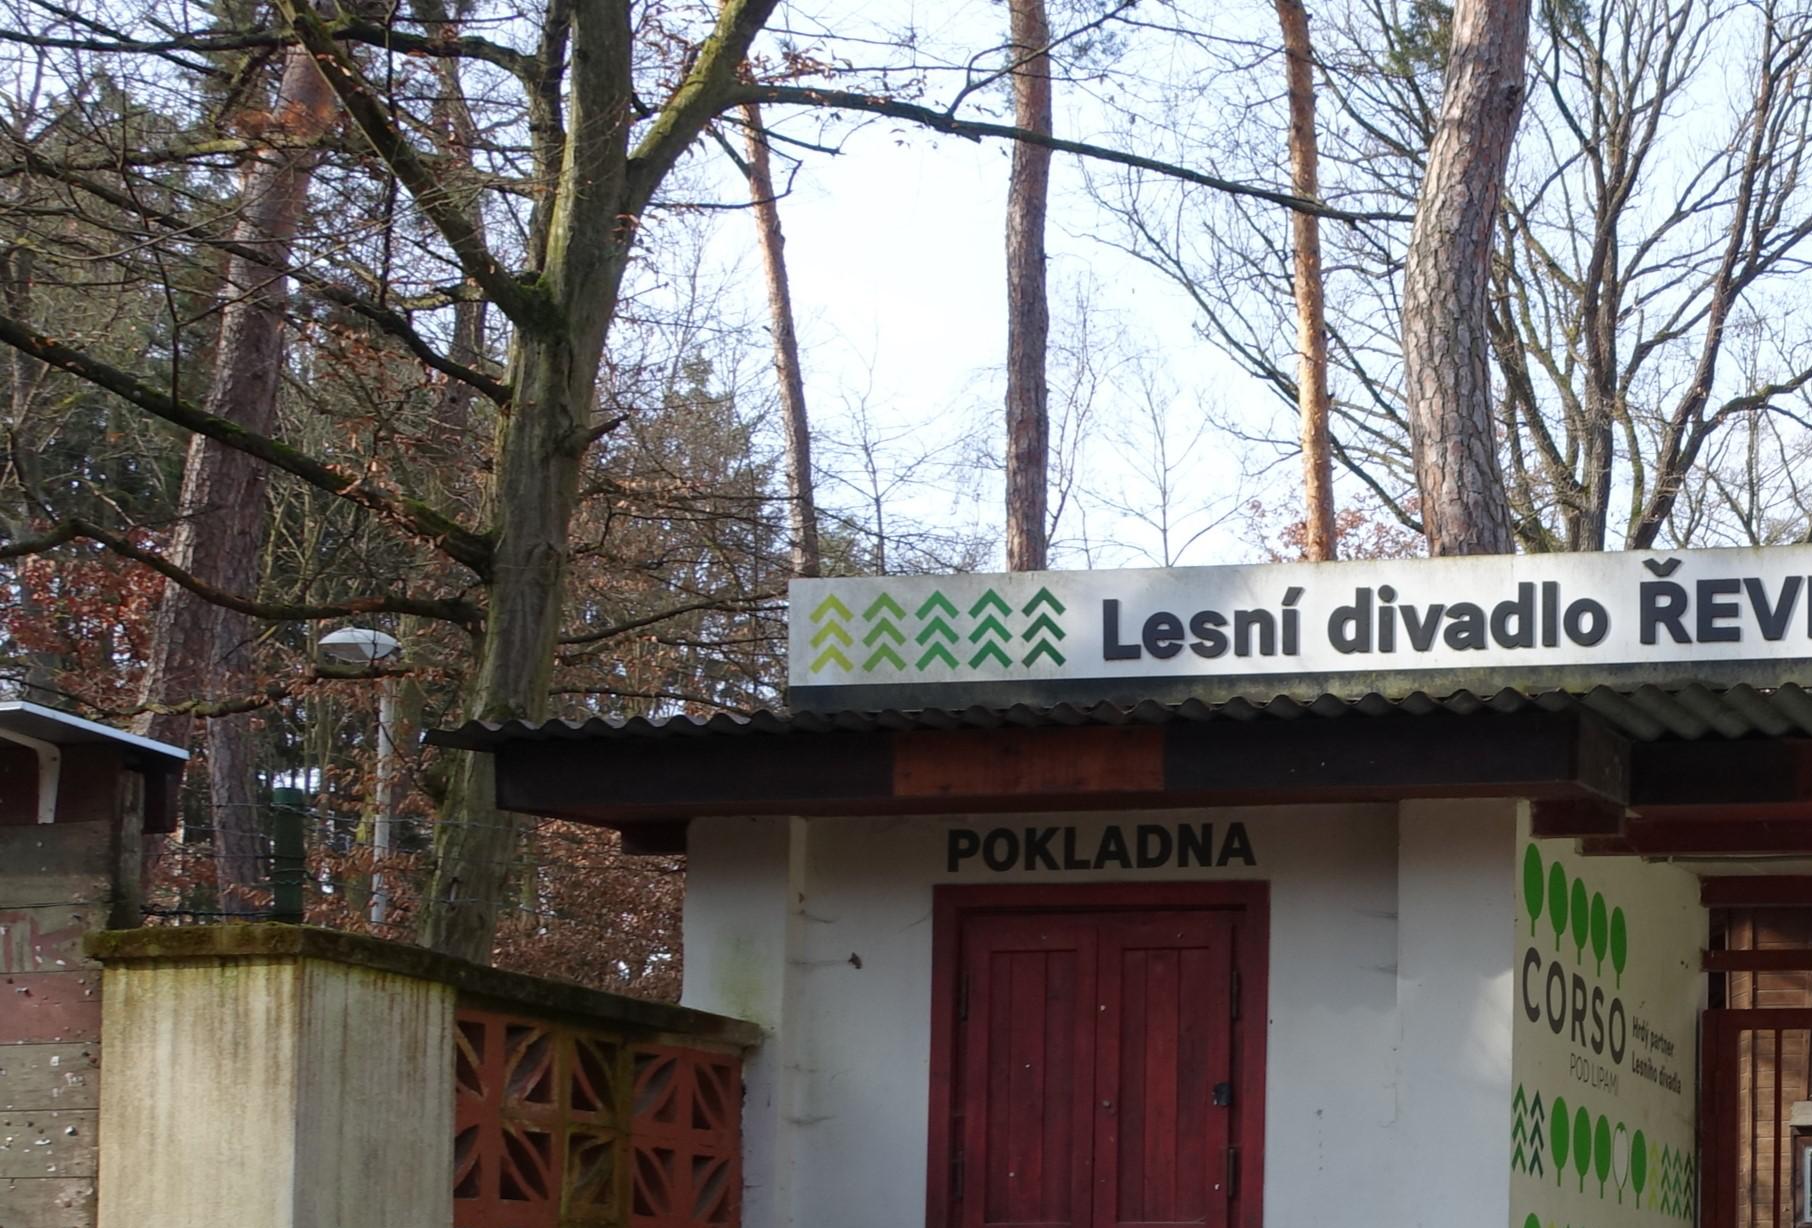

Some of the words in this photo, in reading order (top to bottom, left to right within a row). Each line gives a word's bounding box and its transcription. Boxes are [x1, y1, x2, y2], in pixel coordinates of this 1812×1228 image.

[1102, 586, 1304, 661] Lesní
[1327, 580, 1610, 654] divadlo
[946, 822, 1257, 873] POKLADNA
[1522, 947, 1626, 1065] CORSO
[1632, 1015, 1649, 1050] Hrdý
[1650, 1030, 1675, 1056] partner
[1569, 1052, 1590, 1083] POD
[1659, 1064, 1681, 1095] divadla
